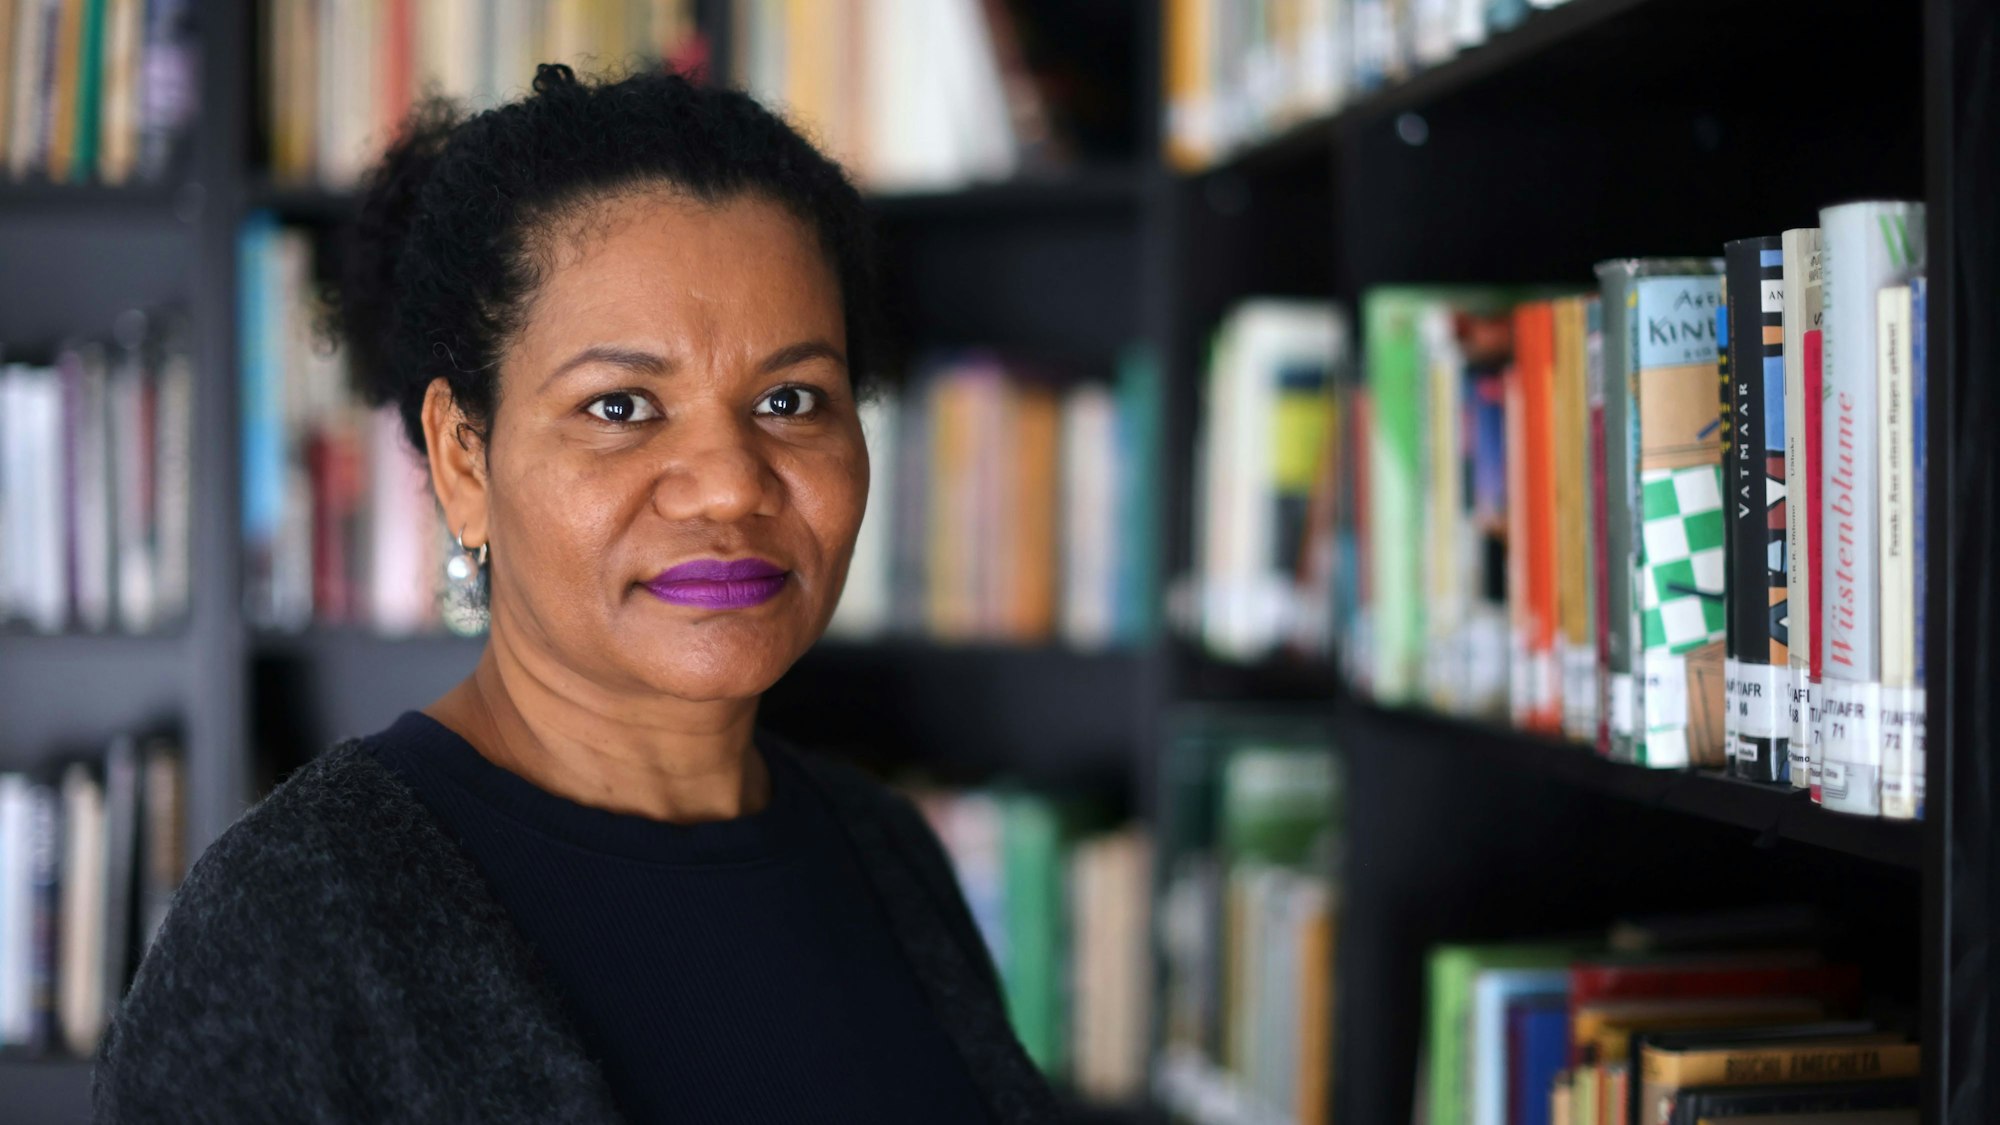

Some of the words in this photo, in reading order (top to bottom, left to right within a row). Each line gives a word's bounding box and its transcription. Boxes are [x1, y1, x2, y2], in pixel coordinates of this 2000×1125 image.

[1738, 383, 1750, 518] VATMAAR
[1831, 392, 1854, 667] Wüstenblume
[1832, 722, 1845, 739] 71
